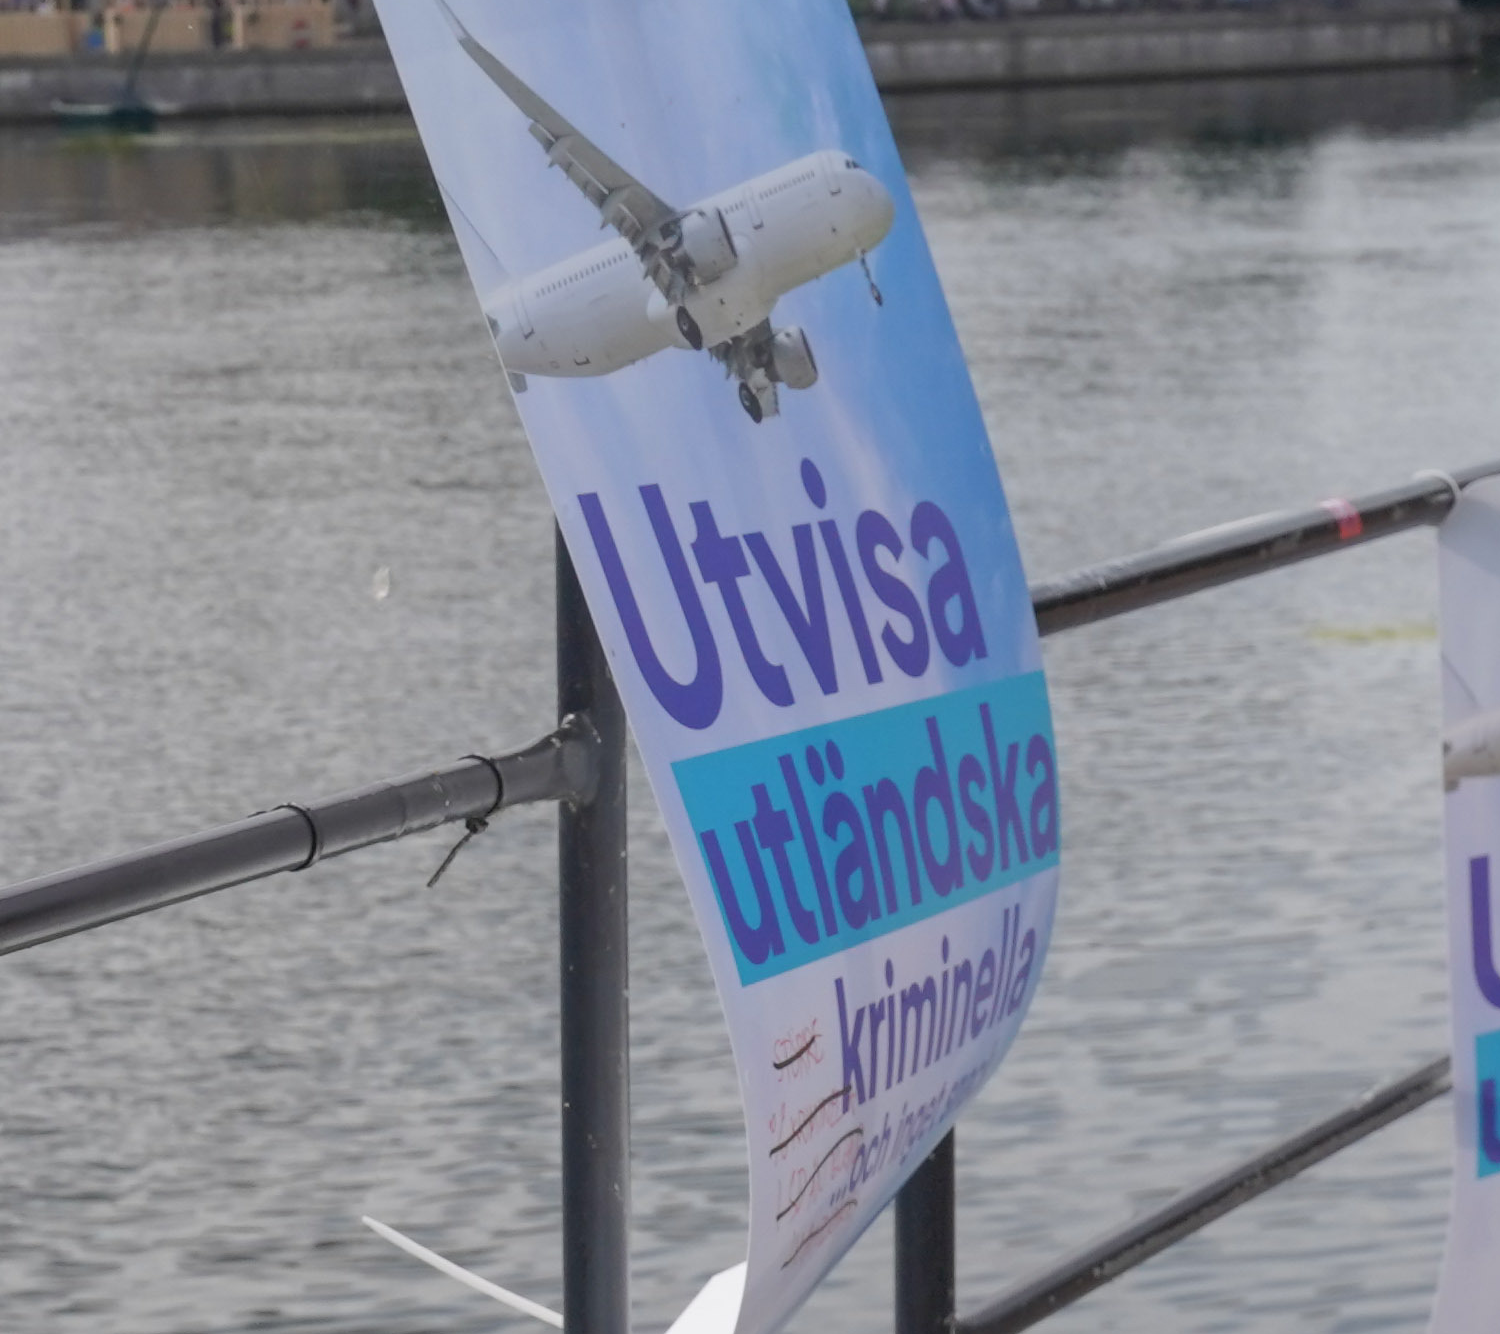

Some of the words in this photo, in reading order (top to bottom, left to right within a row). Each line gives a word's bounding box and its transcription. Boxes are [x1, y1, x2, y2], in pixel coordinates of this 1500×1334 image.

[577, 456, 988, 731] Utvisa
[700, 701, 1058, 967] utländska
[834, 903, 1038, 1116] kriminella
